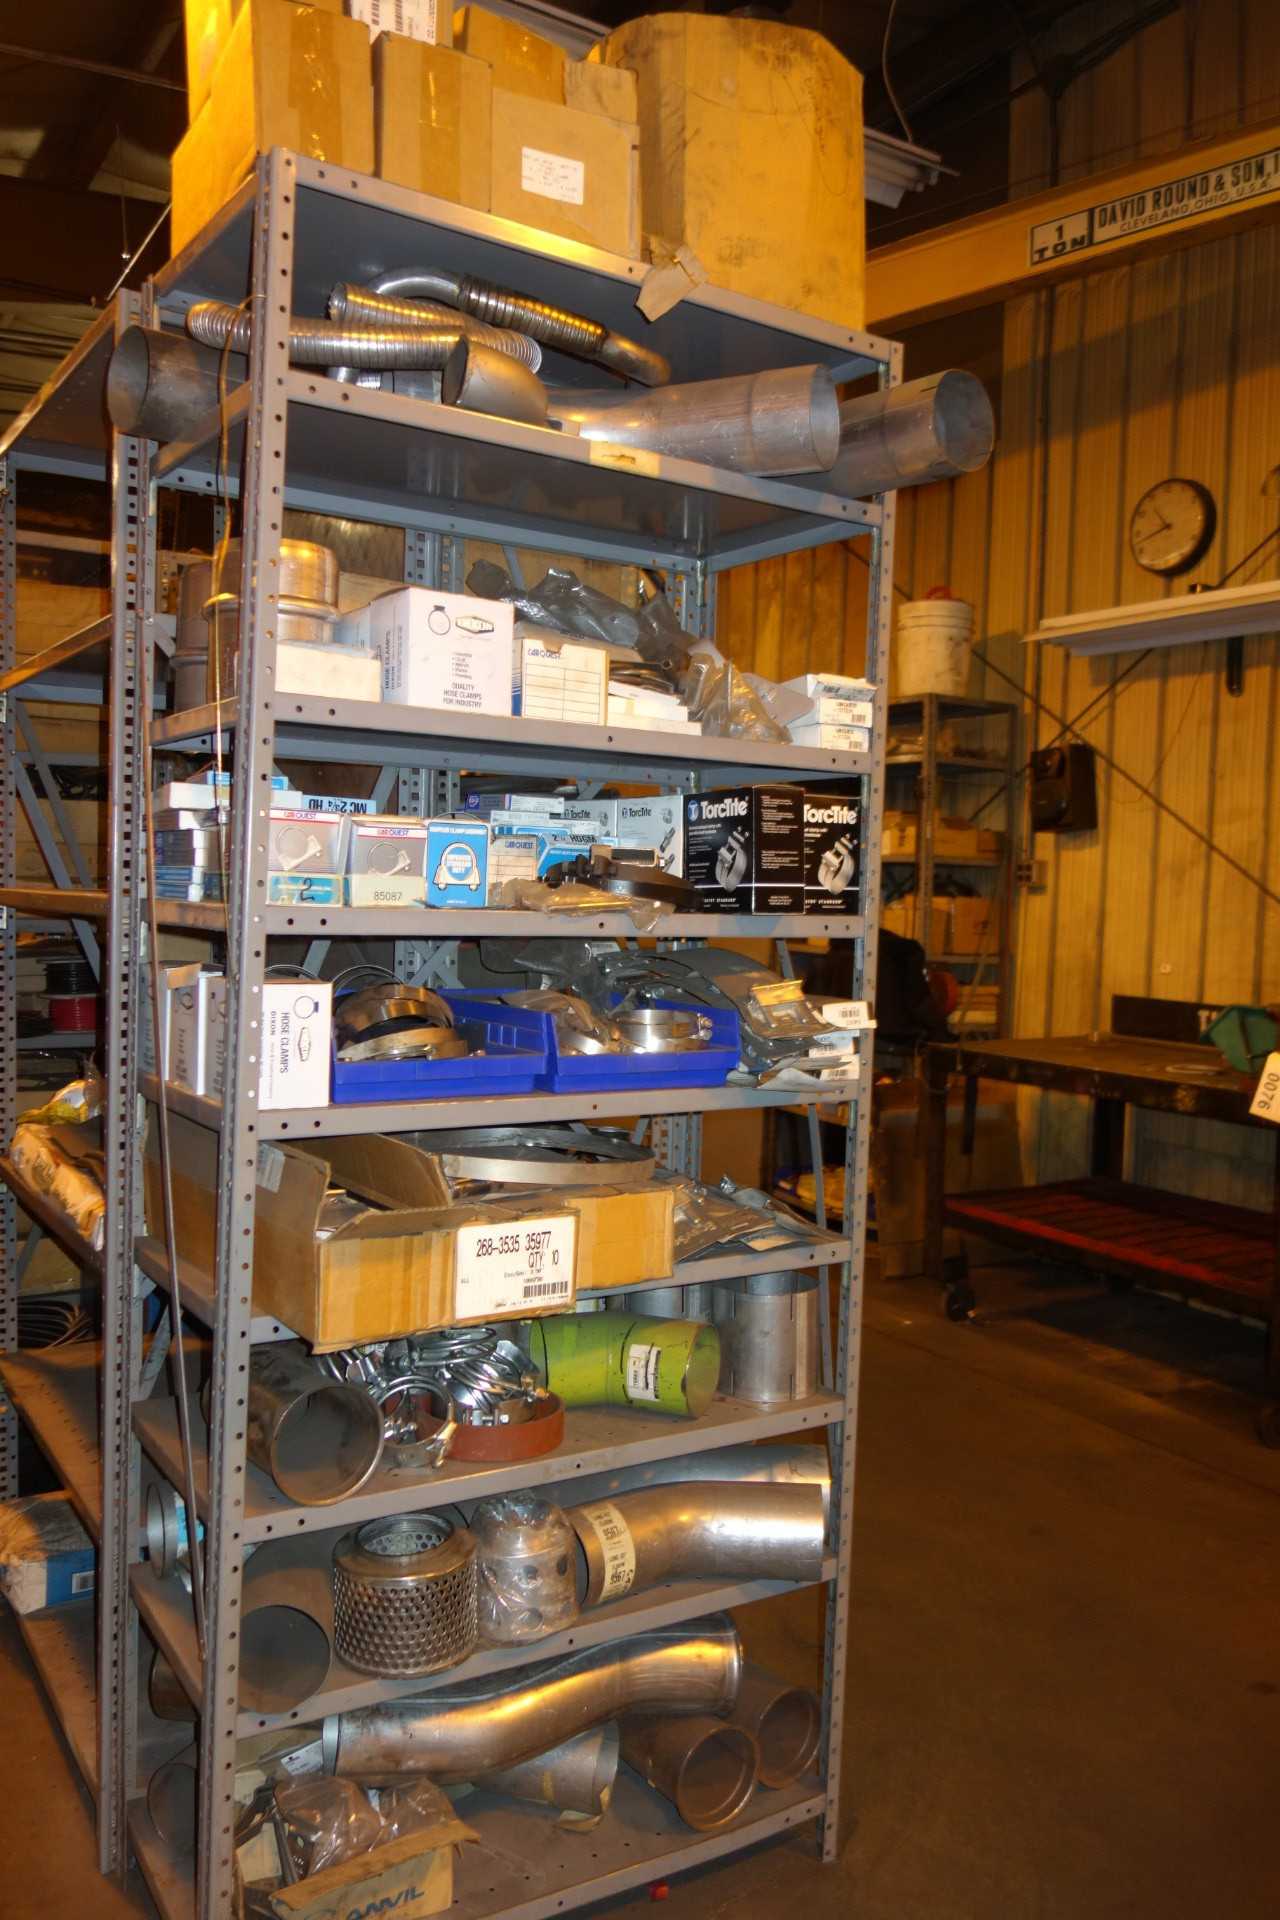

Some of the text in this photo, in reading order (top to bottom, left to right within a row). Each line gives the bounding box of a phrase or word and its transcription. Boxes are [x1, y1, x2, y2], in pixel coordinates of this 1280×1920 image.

[1099, 194, 1146, 229] DAVID
[1152, 174, 1209, 212] ROUND
[1215, 174, 1225, 192] &
[1055, 224, 1064, 240] 1
[1034, 234, 1086, 261] TON
[443, 688, 482, 700] HOSE CLAMPS
[452, 682, 475, 692] QUALITY
[629, 807, 652, 818] TorcTite
[700, 797, 748, 819] TorcTite
[803, 804, 858, 825] TorcTite
[373, 891, 402, 902] 85087
[279, 1012, 290, 1074] HOSE CLAMPS
[1257, 1072, 1280, 1111] 0076
[476, 1230, 552, 1257] 268-3535 35977
[552, 1250, 560, 1266] 10
